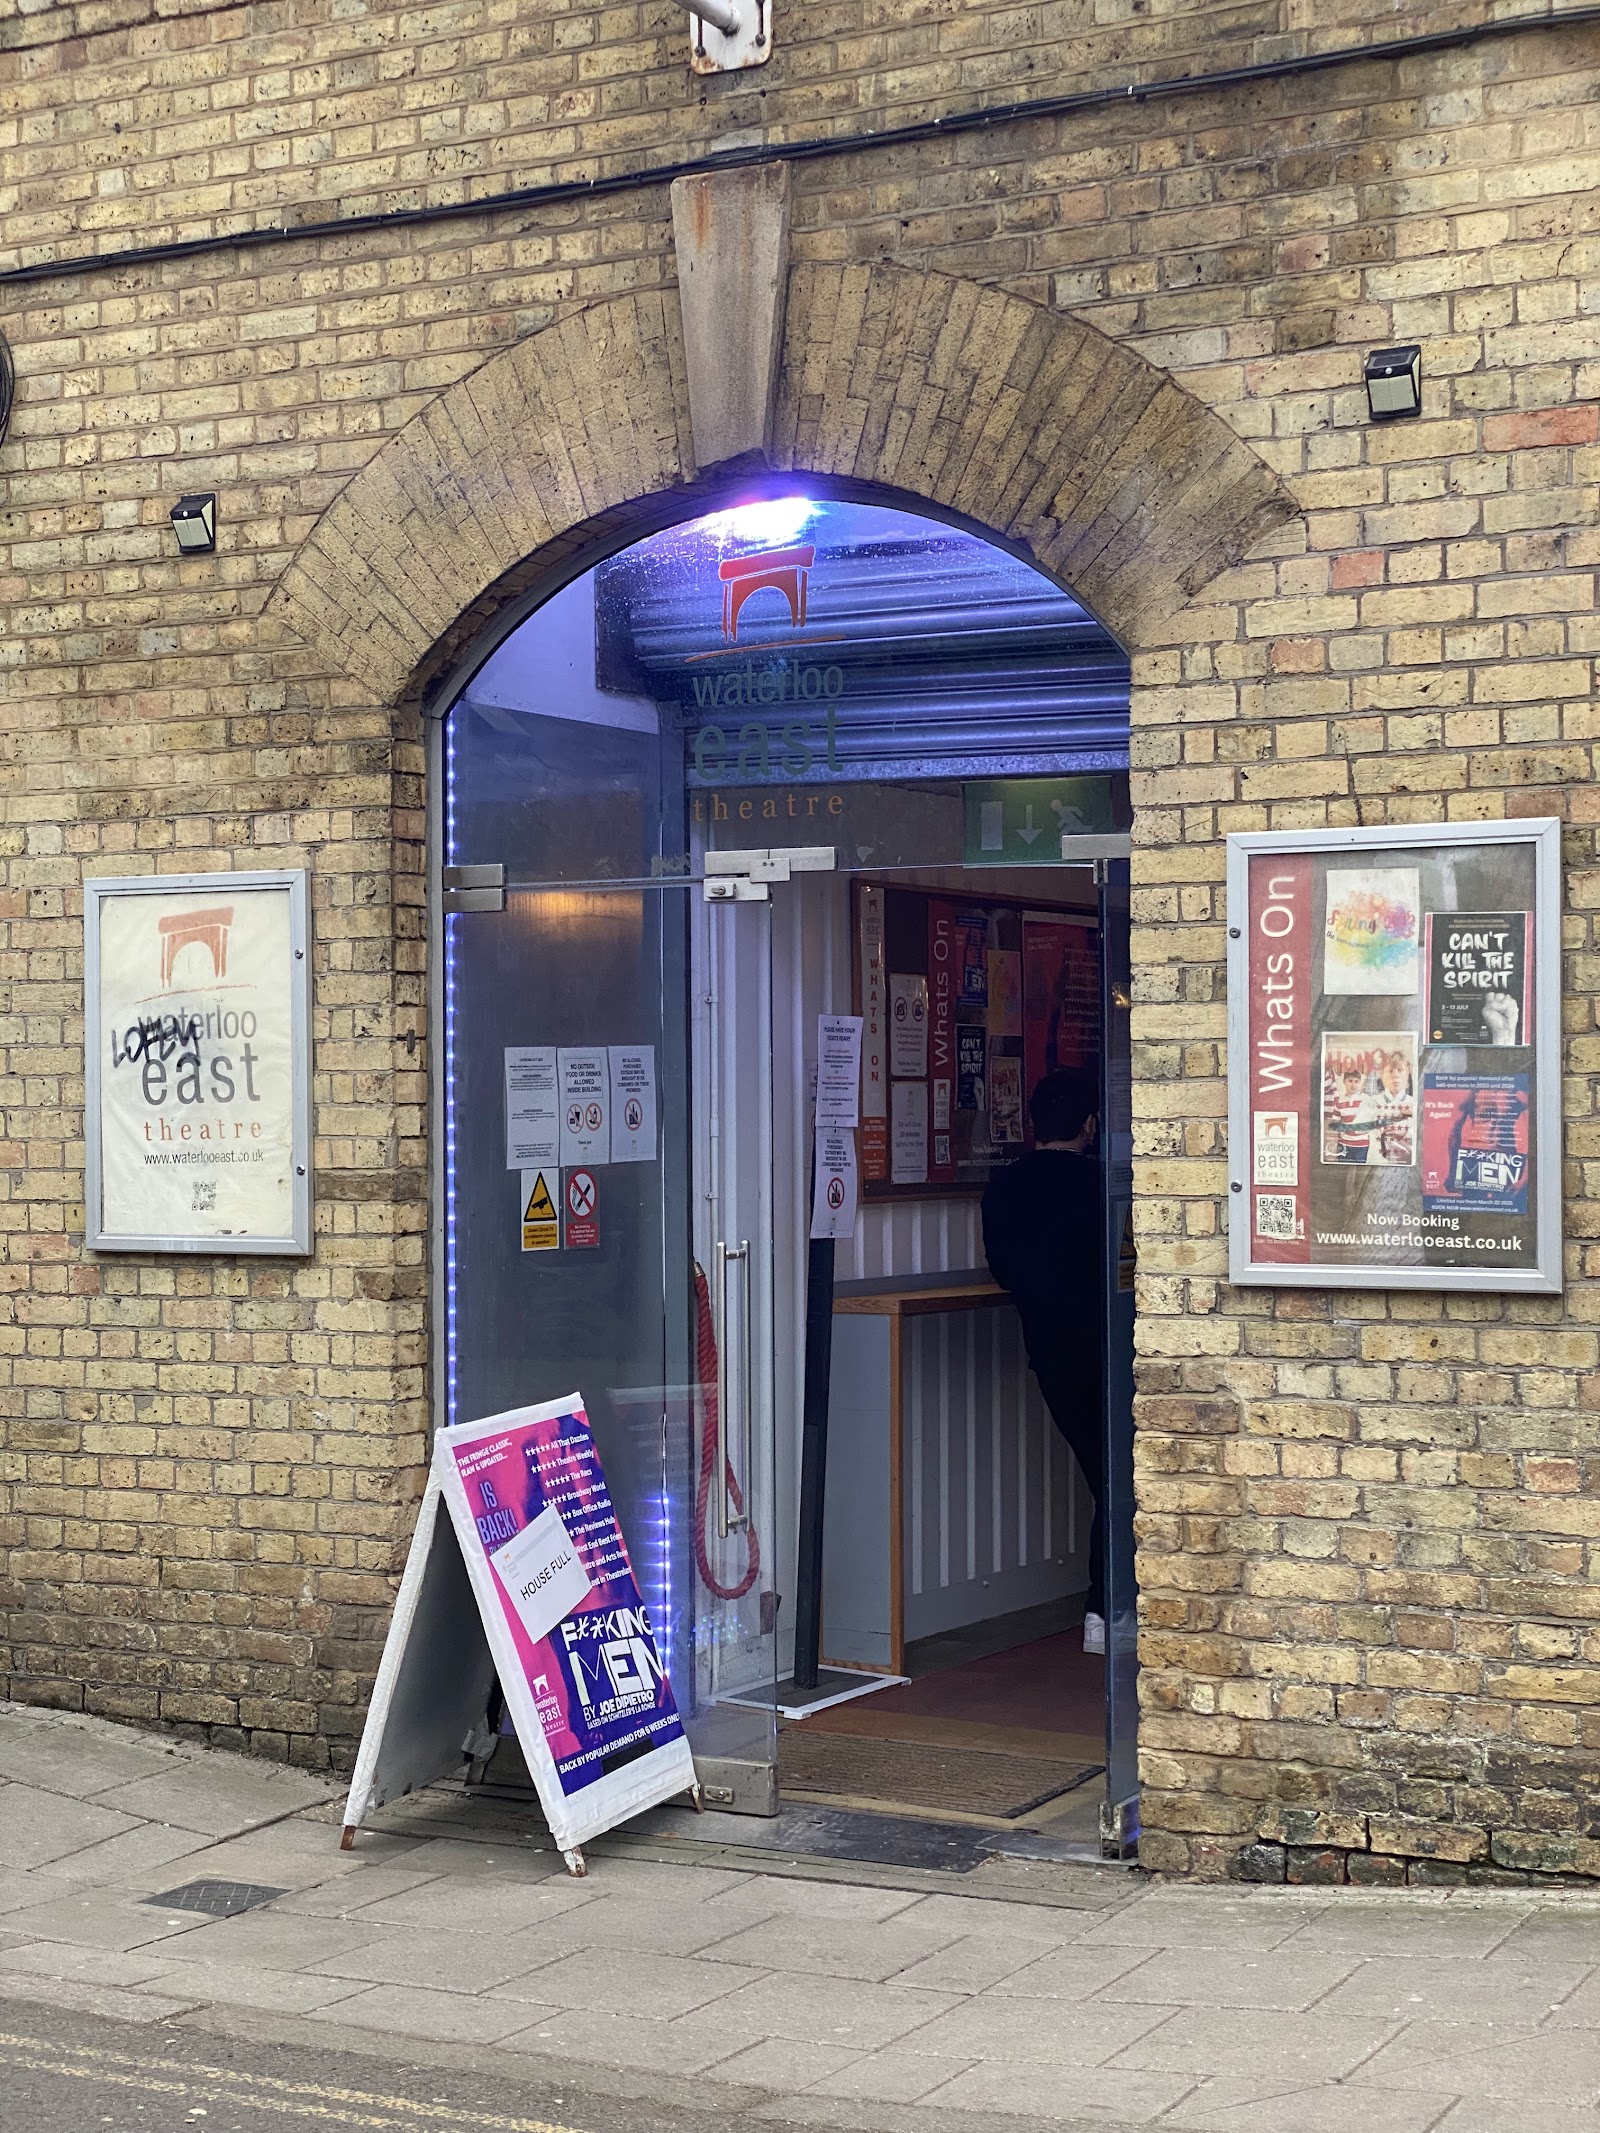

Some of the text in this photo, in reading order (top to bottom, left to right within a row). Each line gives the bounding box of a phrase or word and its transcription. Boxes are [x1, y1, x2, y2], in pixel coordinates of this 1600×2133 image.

[693, 660, 844, 707] waterloo
[695, 704, 844, 780] east
[693, 793, 844, 822] theatre
[1449, 931, 1510, 951] CAN'T
[1441, 952, 1515, 970] KILL THE
[1257, 876, 1295, 1093] Whats On
[1443, 970, 1514, 989] SPIRIT
[933, 919, 949, 1067] Whats On
[139, 1005, 258, 1041] waterloo
[142, 1043, 261, 1105] east
[1429, 1111, 1451, 1119] Again!
[1437, 1101, 1454, 1109] Back
[144, 1118, 262, 1142] theatre
[144, 1149, 264, 1165] www.waterlooeast.co.uk
[1257, 1142, 1295, 1153] waterloo
[1257, 1152, 1295, 1169] east
[1257, 1171, 1295, 1179] theatre
[1455, 1159, 1521, 1186] MEN
[1367, 1213, 1460, 1231] Now Booking
[1316, 1231, 1523, 1251] www.waterlooeast.co.uk
[550, 1433, 589, 1450] All That Dazzles
[457, 1438, 513, 1467] THE FRINGE CLASSIC,
[556, 1449, 594, 1466] Theatre Weekly
[461, 1466, 476, 1478] RAW
[570, 1468, 592, 1480] The Recs
[480, 1481, 498, 1509] IS
[566, 1481, 606, 1501] Broadway World
[572, 1499, 612, 1518] Box Office Radio
[476, 1508, 519, 1544] BACK!
[574, 1515, 615, 1536] The Reviews Hub
[588, 1539, 599, 1550] End
[597, 1535, 610, 1546] Best
[595, 1555, 606, 1567] and
[605, 1551, 618, 1562] Arts
[520, 1567, 553, 1601] HOUSE
[550, 1550, 572, 1575] FULL
[591, 1577, 601, 1587] ost
[599, 1575, 607, 1583] in
[568, 1637, 665, 1706] MEN
[535, 1695, 558, 1710] waterloo
[583, 1690, 655, 1721] BY JOE DIPIETRO
[540, 1703, 562, 1724] east
[586, 1718, 602, 1730] BASED
[559, 1761, 578, 1774] BACK
[576, 1757, 587, 1767] BY
[585, 1743, 611, 1762] POPULAR
[609, 1733, 635, 1750] DEMAND
[633, 1728, 647, 1740] FOR
[645, 1726, 651, 1735] 6
[649, 1718, 668, 1732] WEEKS
